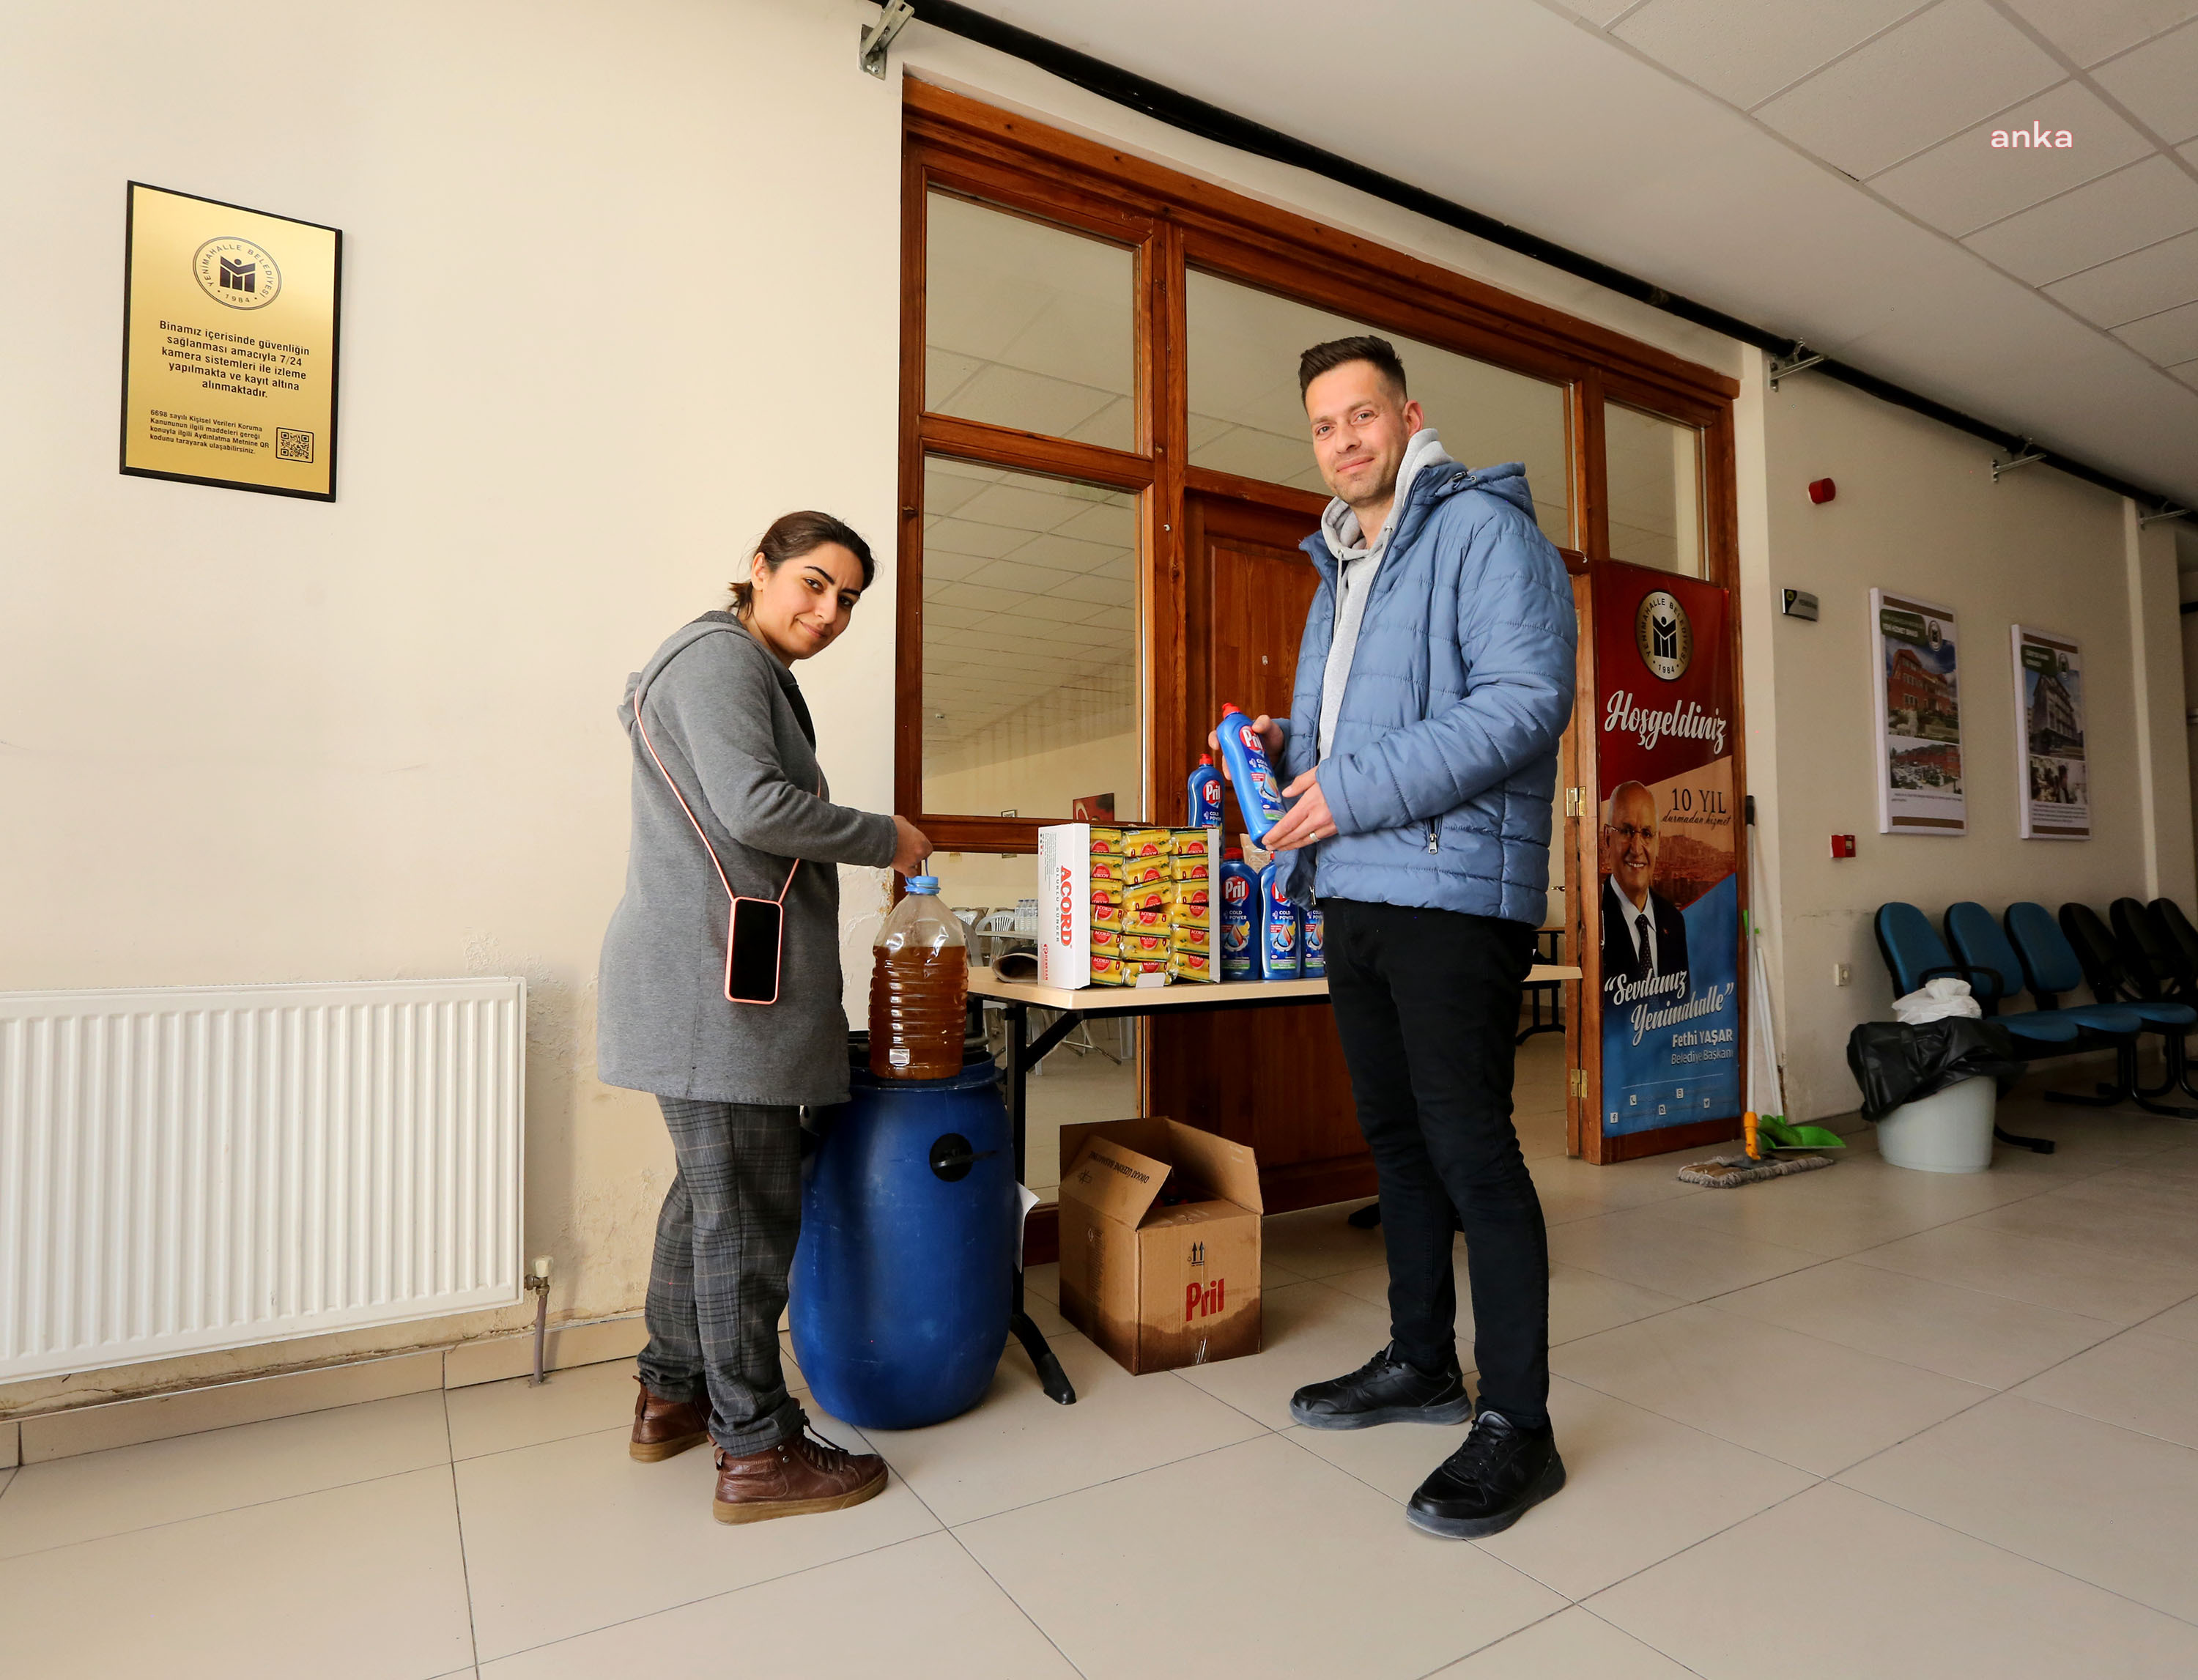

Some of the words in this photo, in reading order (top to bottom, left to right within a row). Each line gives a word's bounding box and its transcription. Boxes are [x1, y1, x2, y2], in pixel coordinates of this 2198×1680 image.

[225, 293, 251, 303] 1984
[160, 320, 202, 336] Binamız
[205, 329, 256, 346] içerisinde
[259, 340, 309, 355] güvenliğin
[167, 336, 227, 353] sağlanması
[231, 347, 276, 362] amacıyla
[280, 355, 302, 366] 7/24
[162, 347, 201, 361] kamera
[205, 355, 256, 371] sistemleri
[259, 363, 271, 374] ile
[275, 366, 306, 380] izleme
[169, 362, 226, 378] yapılmakta
[229, 373, 241, 381] ve
[245, 374, 269, 386] kayıt
[272, 379, 300, 391] altına
[202, 380, 267, 398] alınmaktadır.
[150, 409, 168, 418] 6698
[189, 415, 211, 423] Kişisel
[212, 418, 236, 428] Verileri
[238, 423, 262, 432] Koruma
[150, 418, 188, 428] Kanununun
[205, 426, 238, 436] maddeleri
[240, 432, 260, 440] gereği
[149, 433, 174, 443] kodunu
[176, 437, 207, 447] tarayarak
[209, 443, 256, 454] ulaşabilirsiniz.
[150, 425, 176, 434] konuyla
[194, 432, 231, 443] Aydınlatma
[232, 437, 258, 447] Metnine
[1659, 664, 1675, 674] 1984
[1604, 690, 1727, 755] Hoşgeldiniz
[1242, 728, 1263, 750] Pril
[1205, 784, 1221, 802] Pril
[1671, 788, 1692, 812] 10
[1698, 790, 1727, 814] YIL
[1660, 809, 1704, 824] durmadan
[1225, 880, 1246, 900] Pril
[1061, 865, 1073, 947] ACORD
[1672, 1030, 1698, 1048] Fethi
[1699, 1029, 1733, 1045] YAŞAR
[1671, 1052, 1702, 1065] Belediye
[1703, 1048, 1733, 1062] Başkanı
[1131, 1170, 1150, 1184] DİKKAT
[1185, 1278, 1225, 1322] Pril
